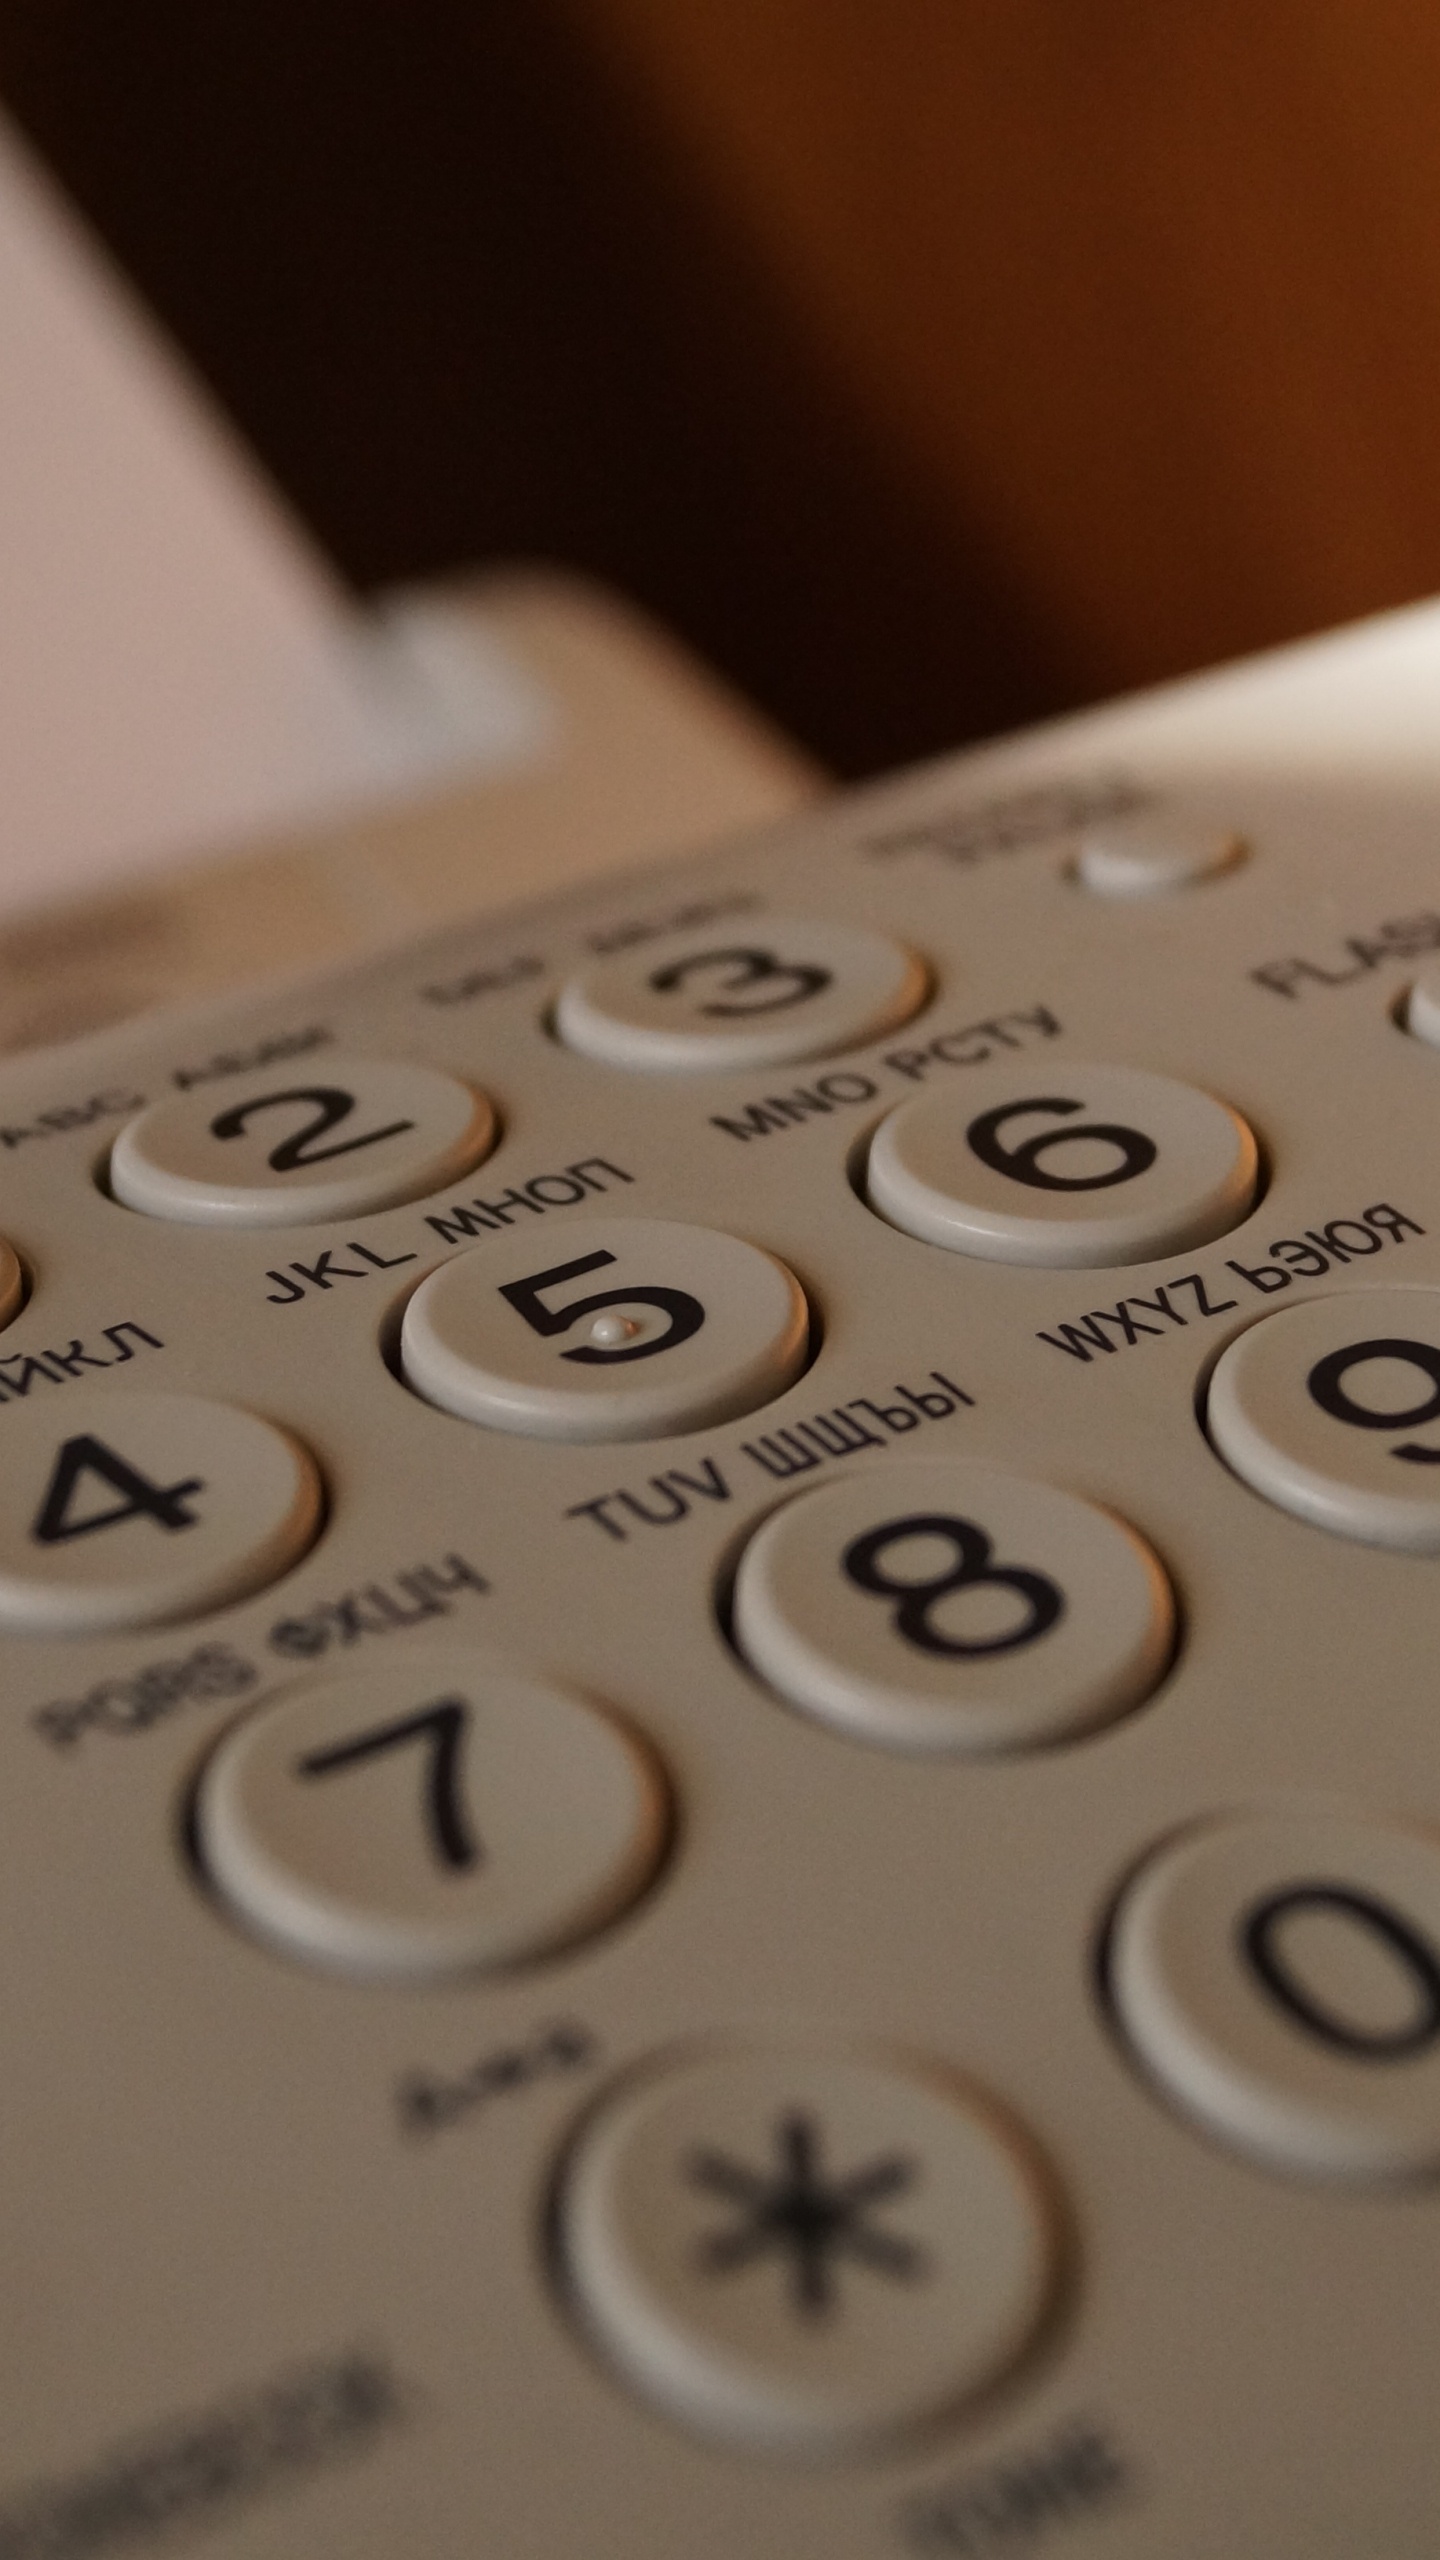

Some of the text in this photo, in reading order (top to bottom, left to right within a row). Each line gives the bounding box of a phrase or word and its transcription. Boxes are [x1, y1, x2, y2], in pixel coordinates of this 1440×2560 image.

[648, 944, 831, 1017] 3
[209, 1083, 418, 1174] 2
[710, 1005, 1061, 1142] MNO РСТУ
[966, 1096, 1158, 1192] 6
[265, 1157, 635, 1303] JKL МНОП
[1035, 1203, 1427, 1362] WXYZ ЬЭЮЯ
[0, 1321, 165, 1402] ЙКЛ
[498, 1249, 706, 1366] 5
[564, 1371, 976, 1542] TUV ШЩЪЫ
[1307, 1338, 1440, 1465] 9
[32, 1432, 206, 1546] 4
[841, 1512, 1066, 1658] 8
[295, 1694, 480, 1875] 7
[1240, 1880, 1440, 2062] 0
